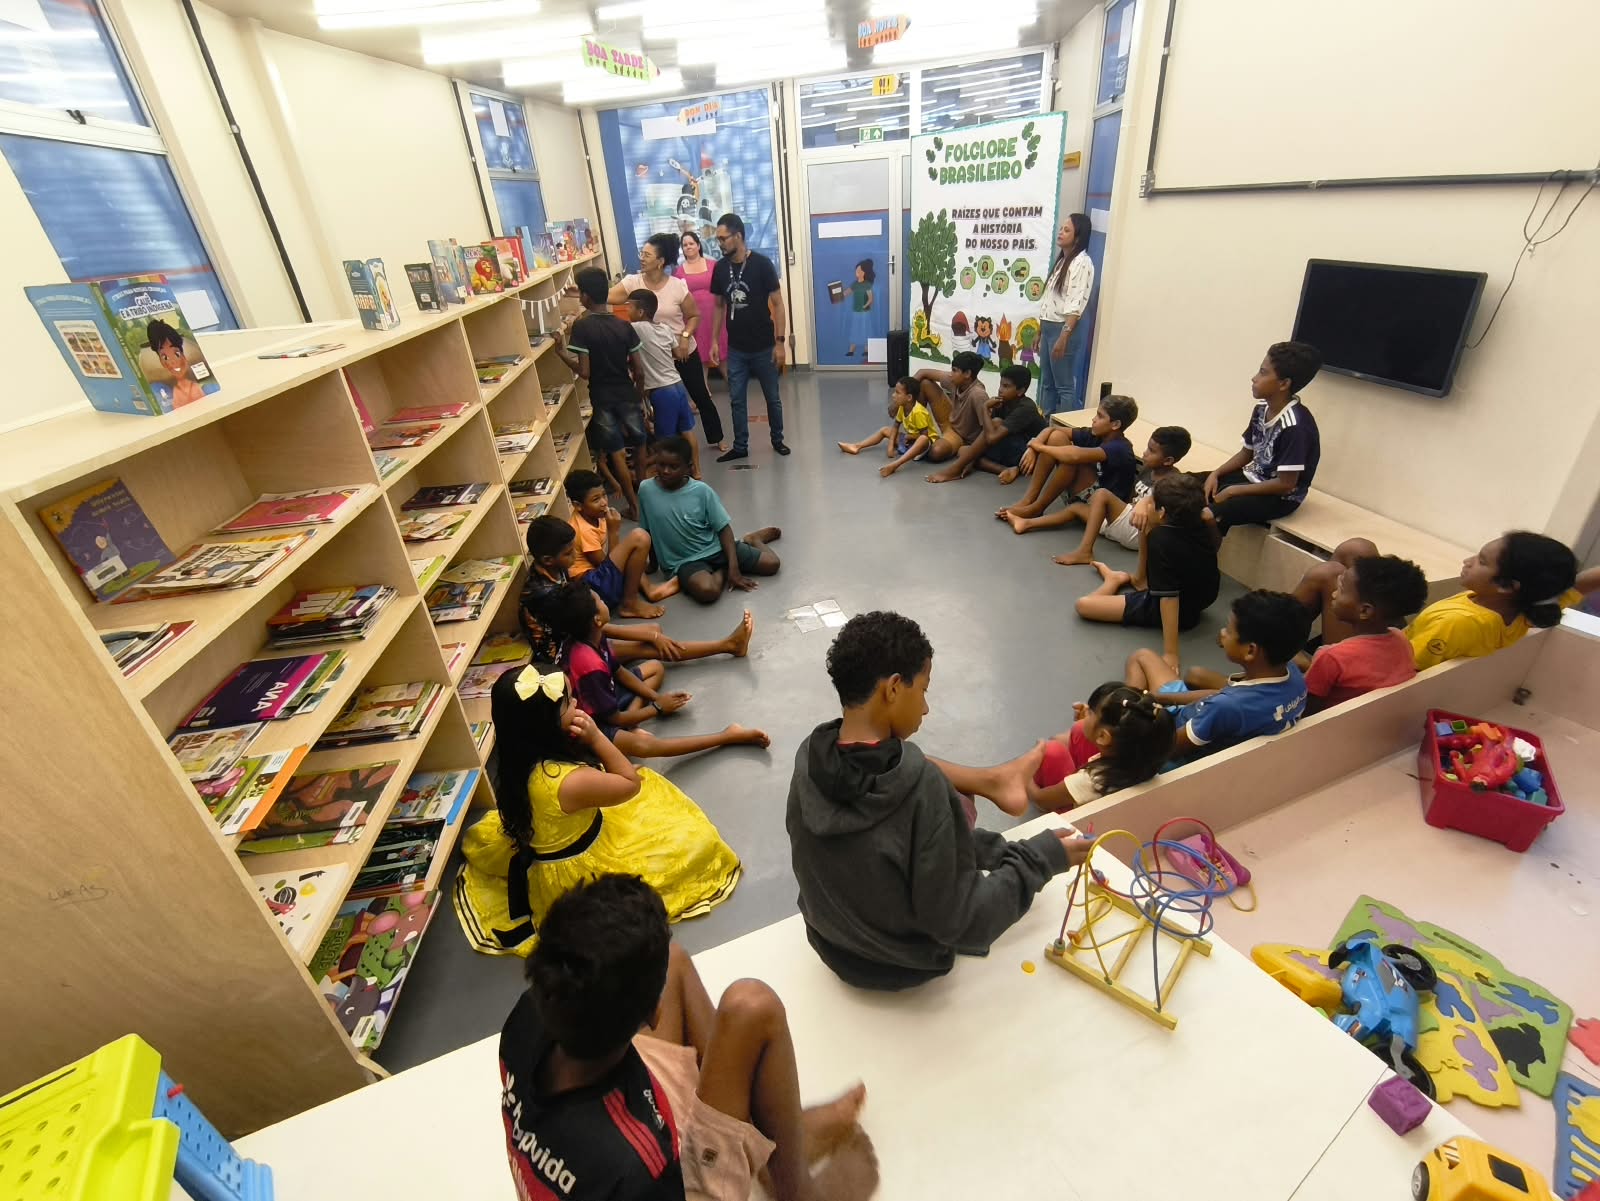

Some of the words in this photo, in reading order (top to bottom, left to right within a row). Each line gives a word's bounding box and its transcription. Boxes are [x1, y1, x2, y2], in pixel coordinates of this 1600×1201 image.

[585, 40, 608, 60] BOA
[611, 49, 645, 69] TARDE
[945, 137, 1018, 163] FOLCLORE
[940, 160, 1023, 185] BRASILEIRO
[951, 205, 981, 219] RAÍZES
[982, 208, 1000, 219] QUE
[1002, 206, 1043, 218] CONTAM
[972, 225, 980, 234] A
[980, 220, 1022, 234] HISTÓRIA
[965, 238, 978, 249] DO
[980, 238, 1009, 250] NOSSO
[130, 305, 148, 317] TRIBO
[512, 1100, 577, 1194] hapvida
